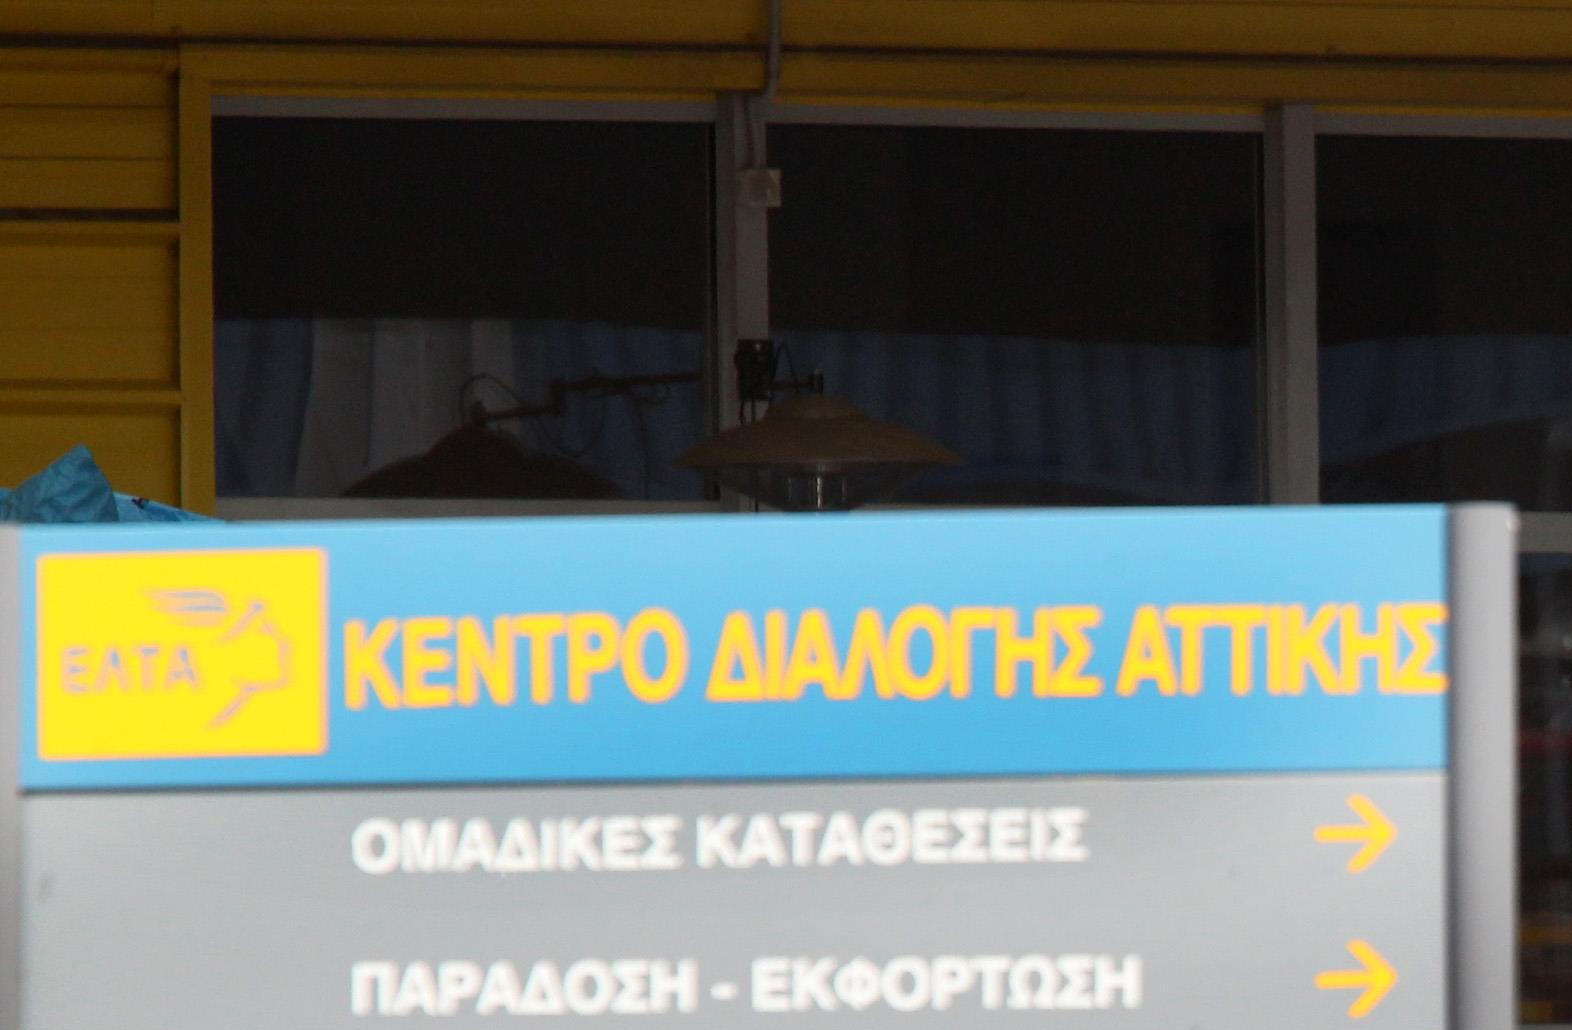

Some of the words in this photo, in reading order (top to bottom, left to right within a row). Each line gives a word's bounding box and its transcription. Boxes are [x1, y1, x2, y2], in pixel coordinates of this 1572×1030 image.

[344, 609, 687, 710] ΚΕΝΤΡΟ
[706, 604, 1101, 702] ΔΙΑΛΟΓΗΣ
[1116, 602, 1448, 700] ΑΤΤΙΚΗΣ
[351, 814, 681, 874] ΟΜΑΔΙΚΕΣ
[695, 806, 1088, 868] ΚΑΤΑΘΕΣΕΙΣ
[350, 961, 697, 1016] ΠΑΡΑΔΟΣΗ
[750, 954, 1143, 1013] ΕΚΦΟΡΤΩΣΗ
